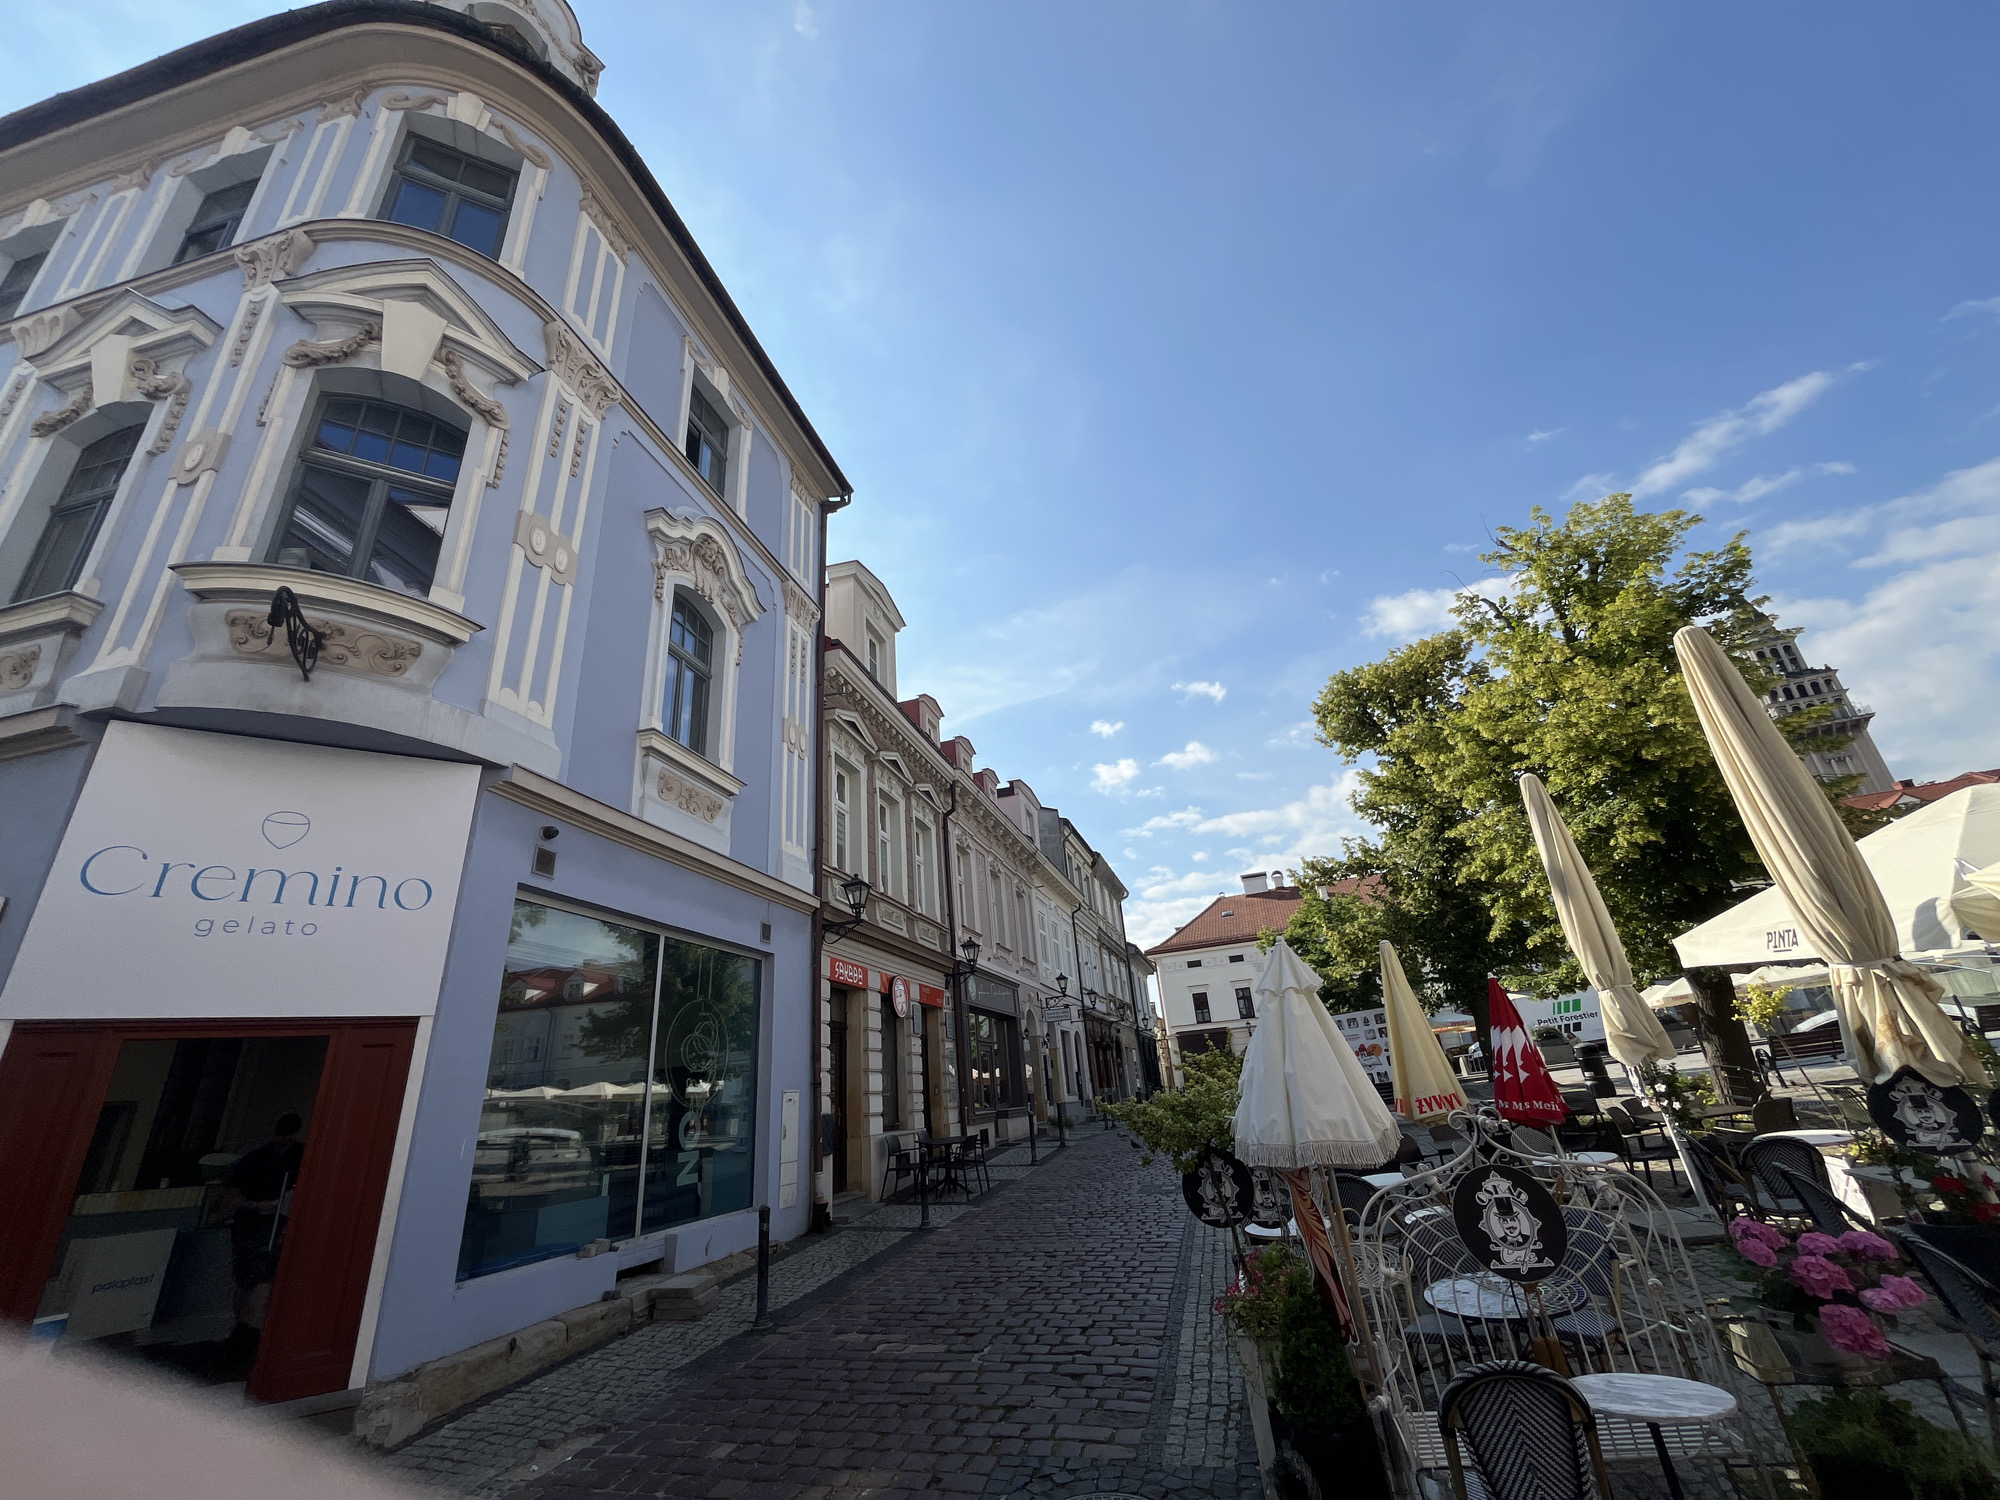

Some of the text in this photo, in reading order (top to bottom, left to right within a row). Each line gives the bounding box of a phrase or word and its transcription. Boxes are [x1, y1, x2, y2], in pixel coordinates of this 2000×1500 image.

[79, 845, 433, 911] Cremino
[194, 915, 318, 937] gelato
[1766, 928, 1799, 950] PINTA
[1559, 1011, 1598, 1023] Forestier
